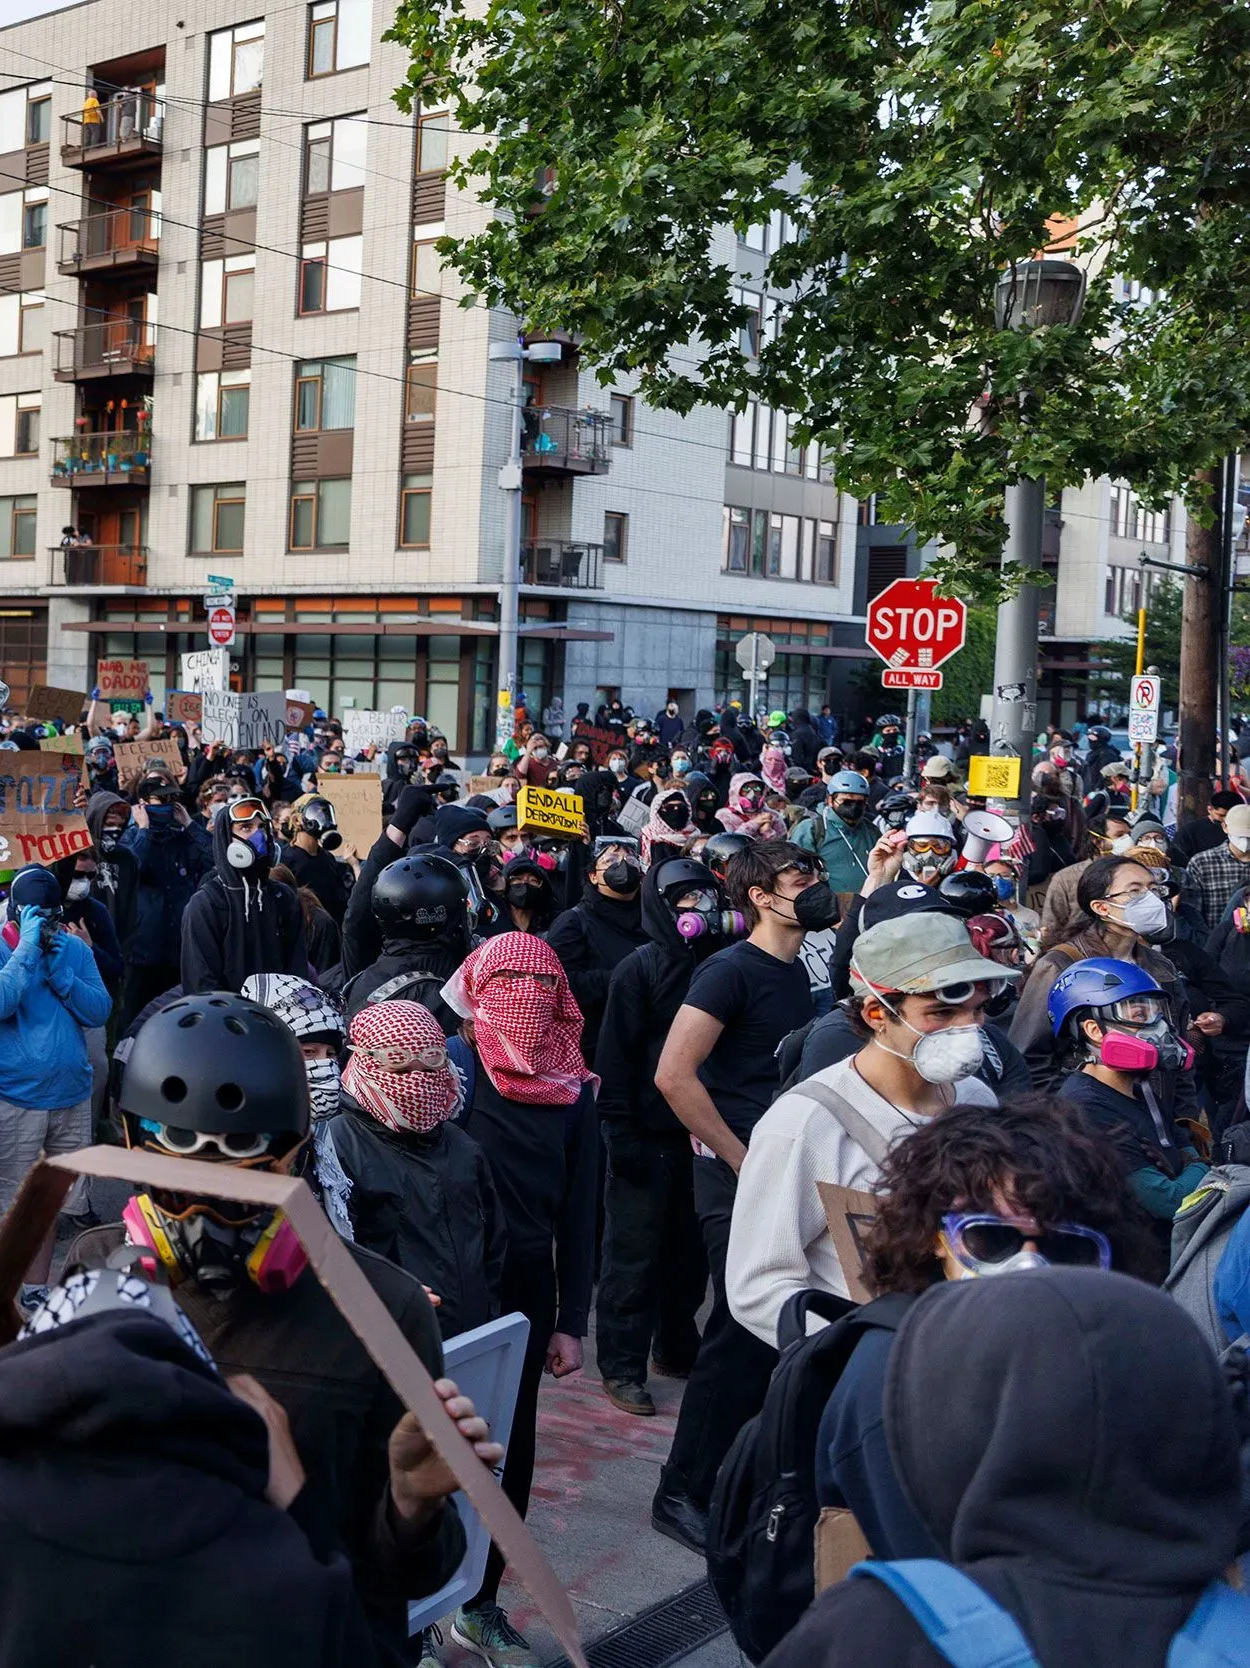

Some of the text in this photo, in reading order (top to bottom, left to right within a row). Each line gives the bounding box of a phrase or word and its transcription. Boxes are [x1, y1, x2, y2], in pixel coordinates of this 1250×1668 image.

[873, 607, 958, 641] STOP
[102, 674, 148, 690] DADDY
[888, 673, 936, 686] ALL WAY
[205, 691, 258, 710] NO ONE IS
[204, 706, 269, 723] ILLEGAL ON
[118, 743, 146, 756] ICE
